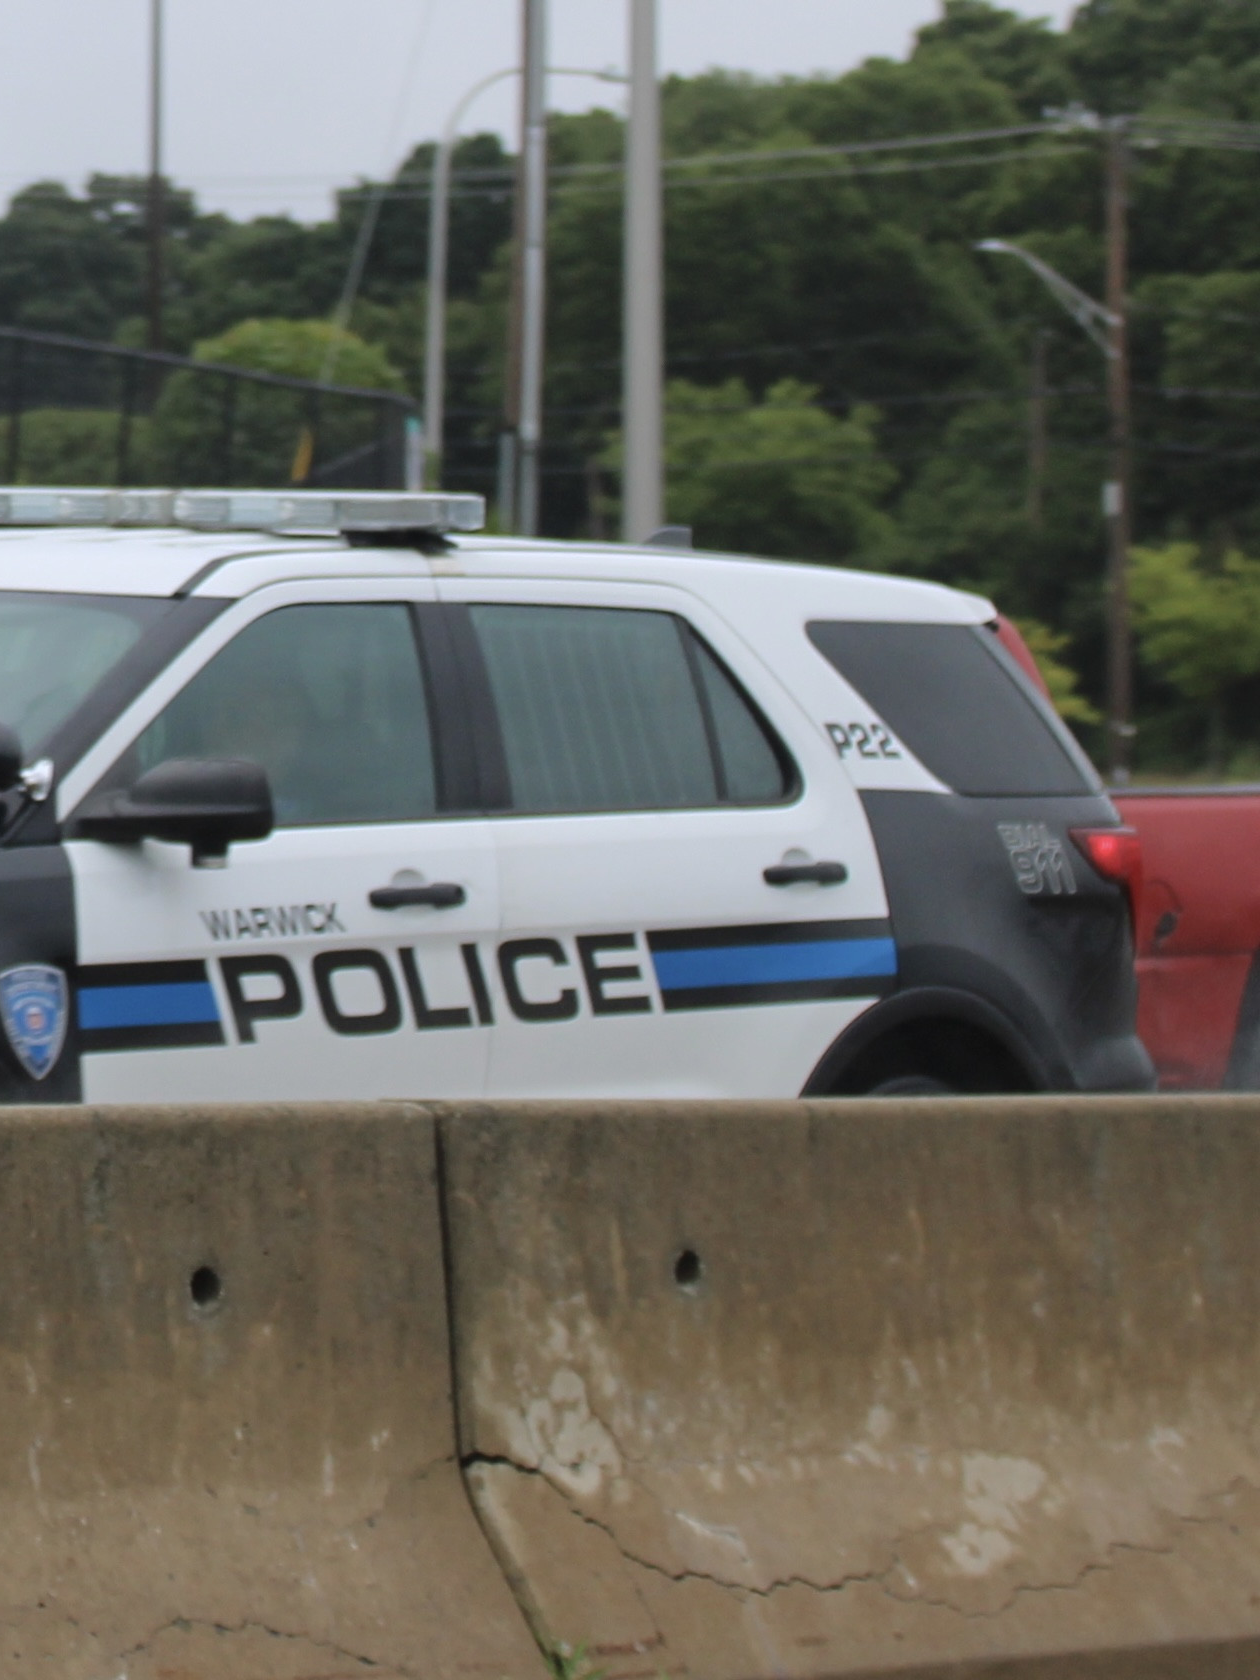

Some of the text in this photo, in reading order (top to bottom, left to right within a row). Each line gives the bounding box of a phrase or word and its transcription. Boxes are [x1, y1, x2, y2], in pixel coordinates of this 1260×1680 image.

[823, 723, 902, 759] P22
[1010, 848, 1077, 894] 911
[198, 902, 346, 940] WARWICK
[218, 932, 654, 1045] POLICE
